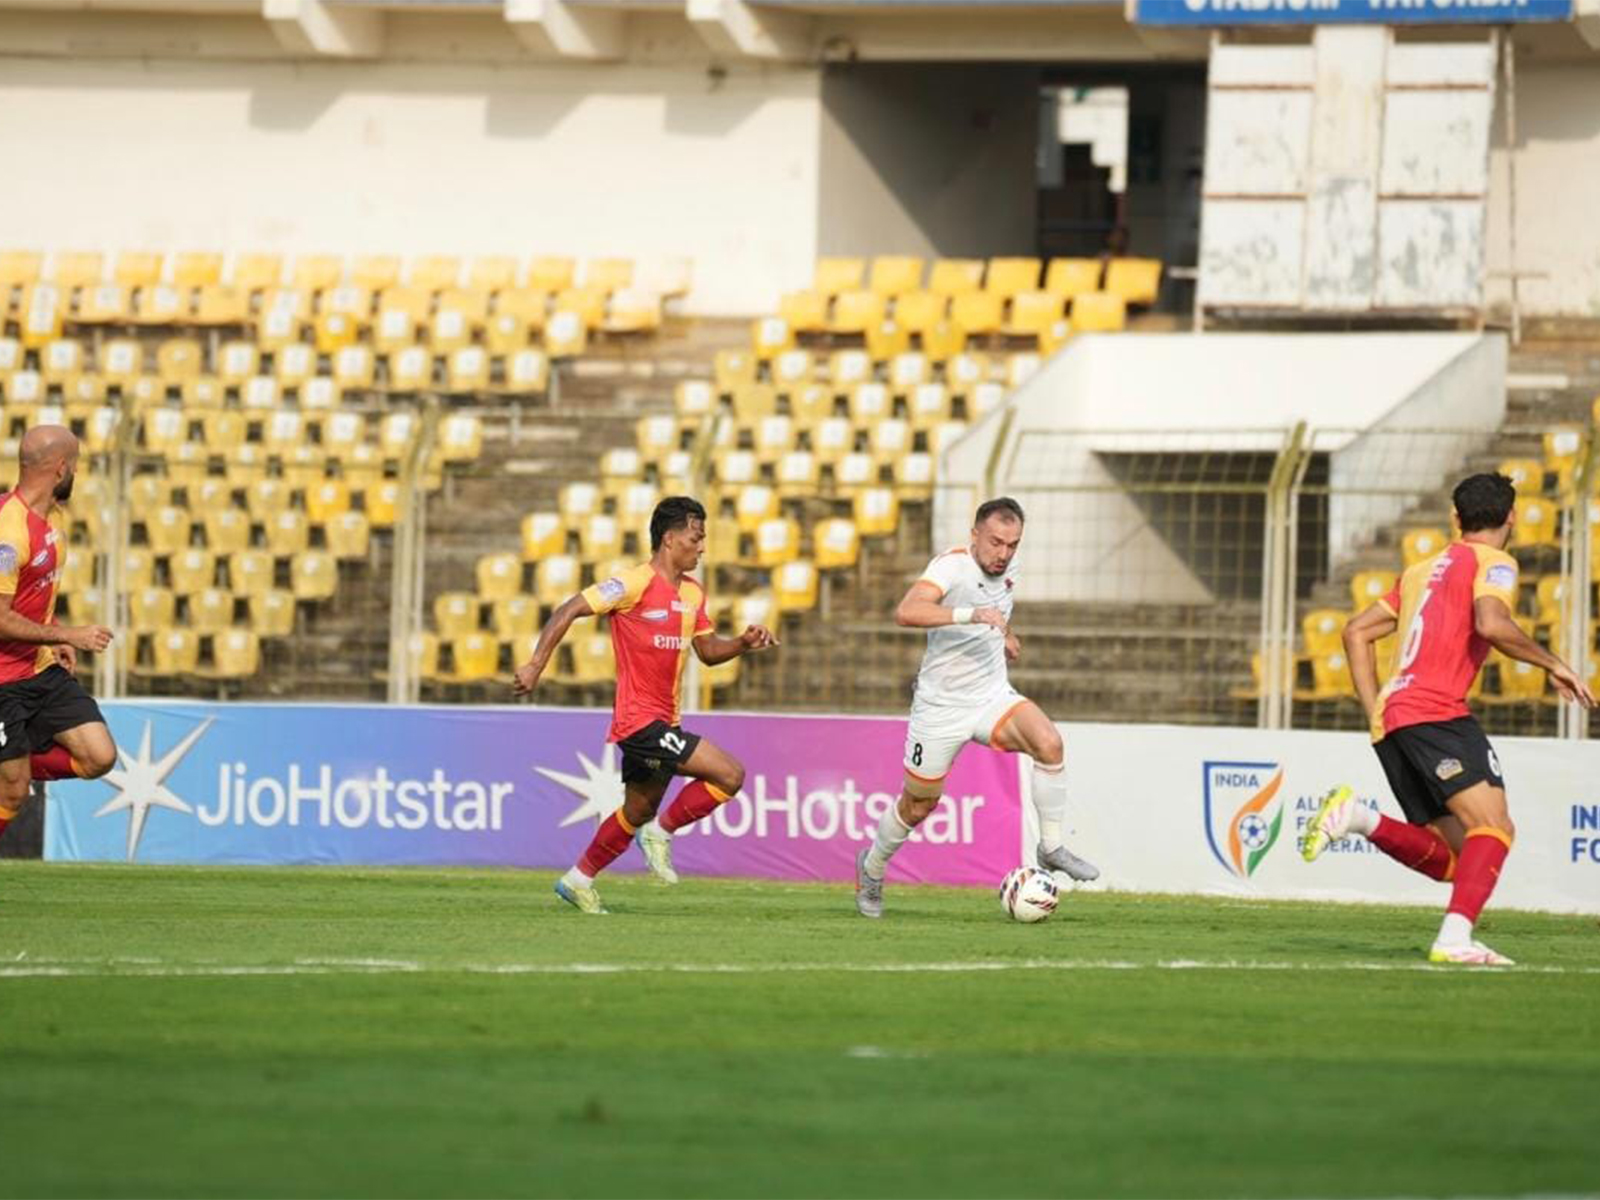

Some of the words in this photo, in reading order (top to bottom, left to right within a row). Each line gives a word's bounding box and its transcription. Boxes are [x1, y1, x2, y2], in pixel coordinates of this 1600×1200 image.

[659, 731, 687, 755] 12
[912, 742, 923, 767] 8
[1215, 773, 1260, 788] INDIA
[196, 762, 515, 831] JioHotstar
[673, 774, 985, 844] oHotsar
